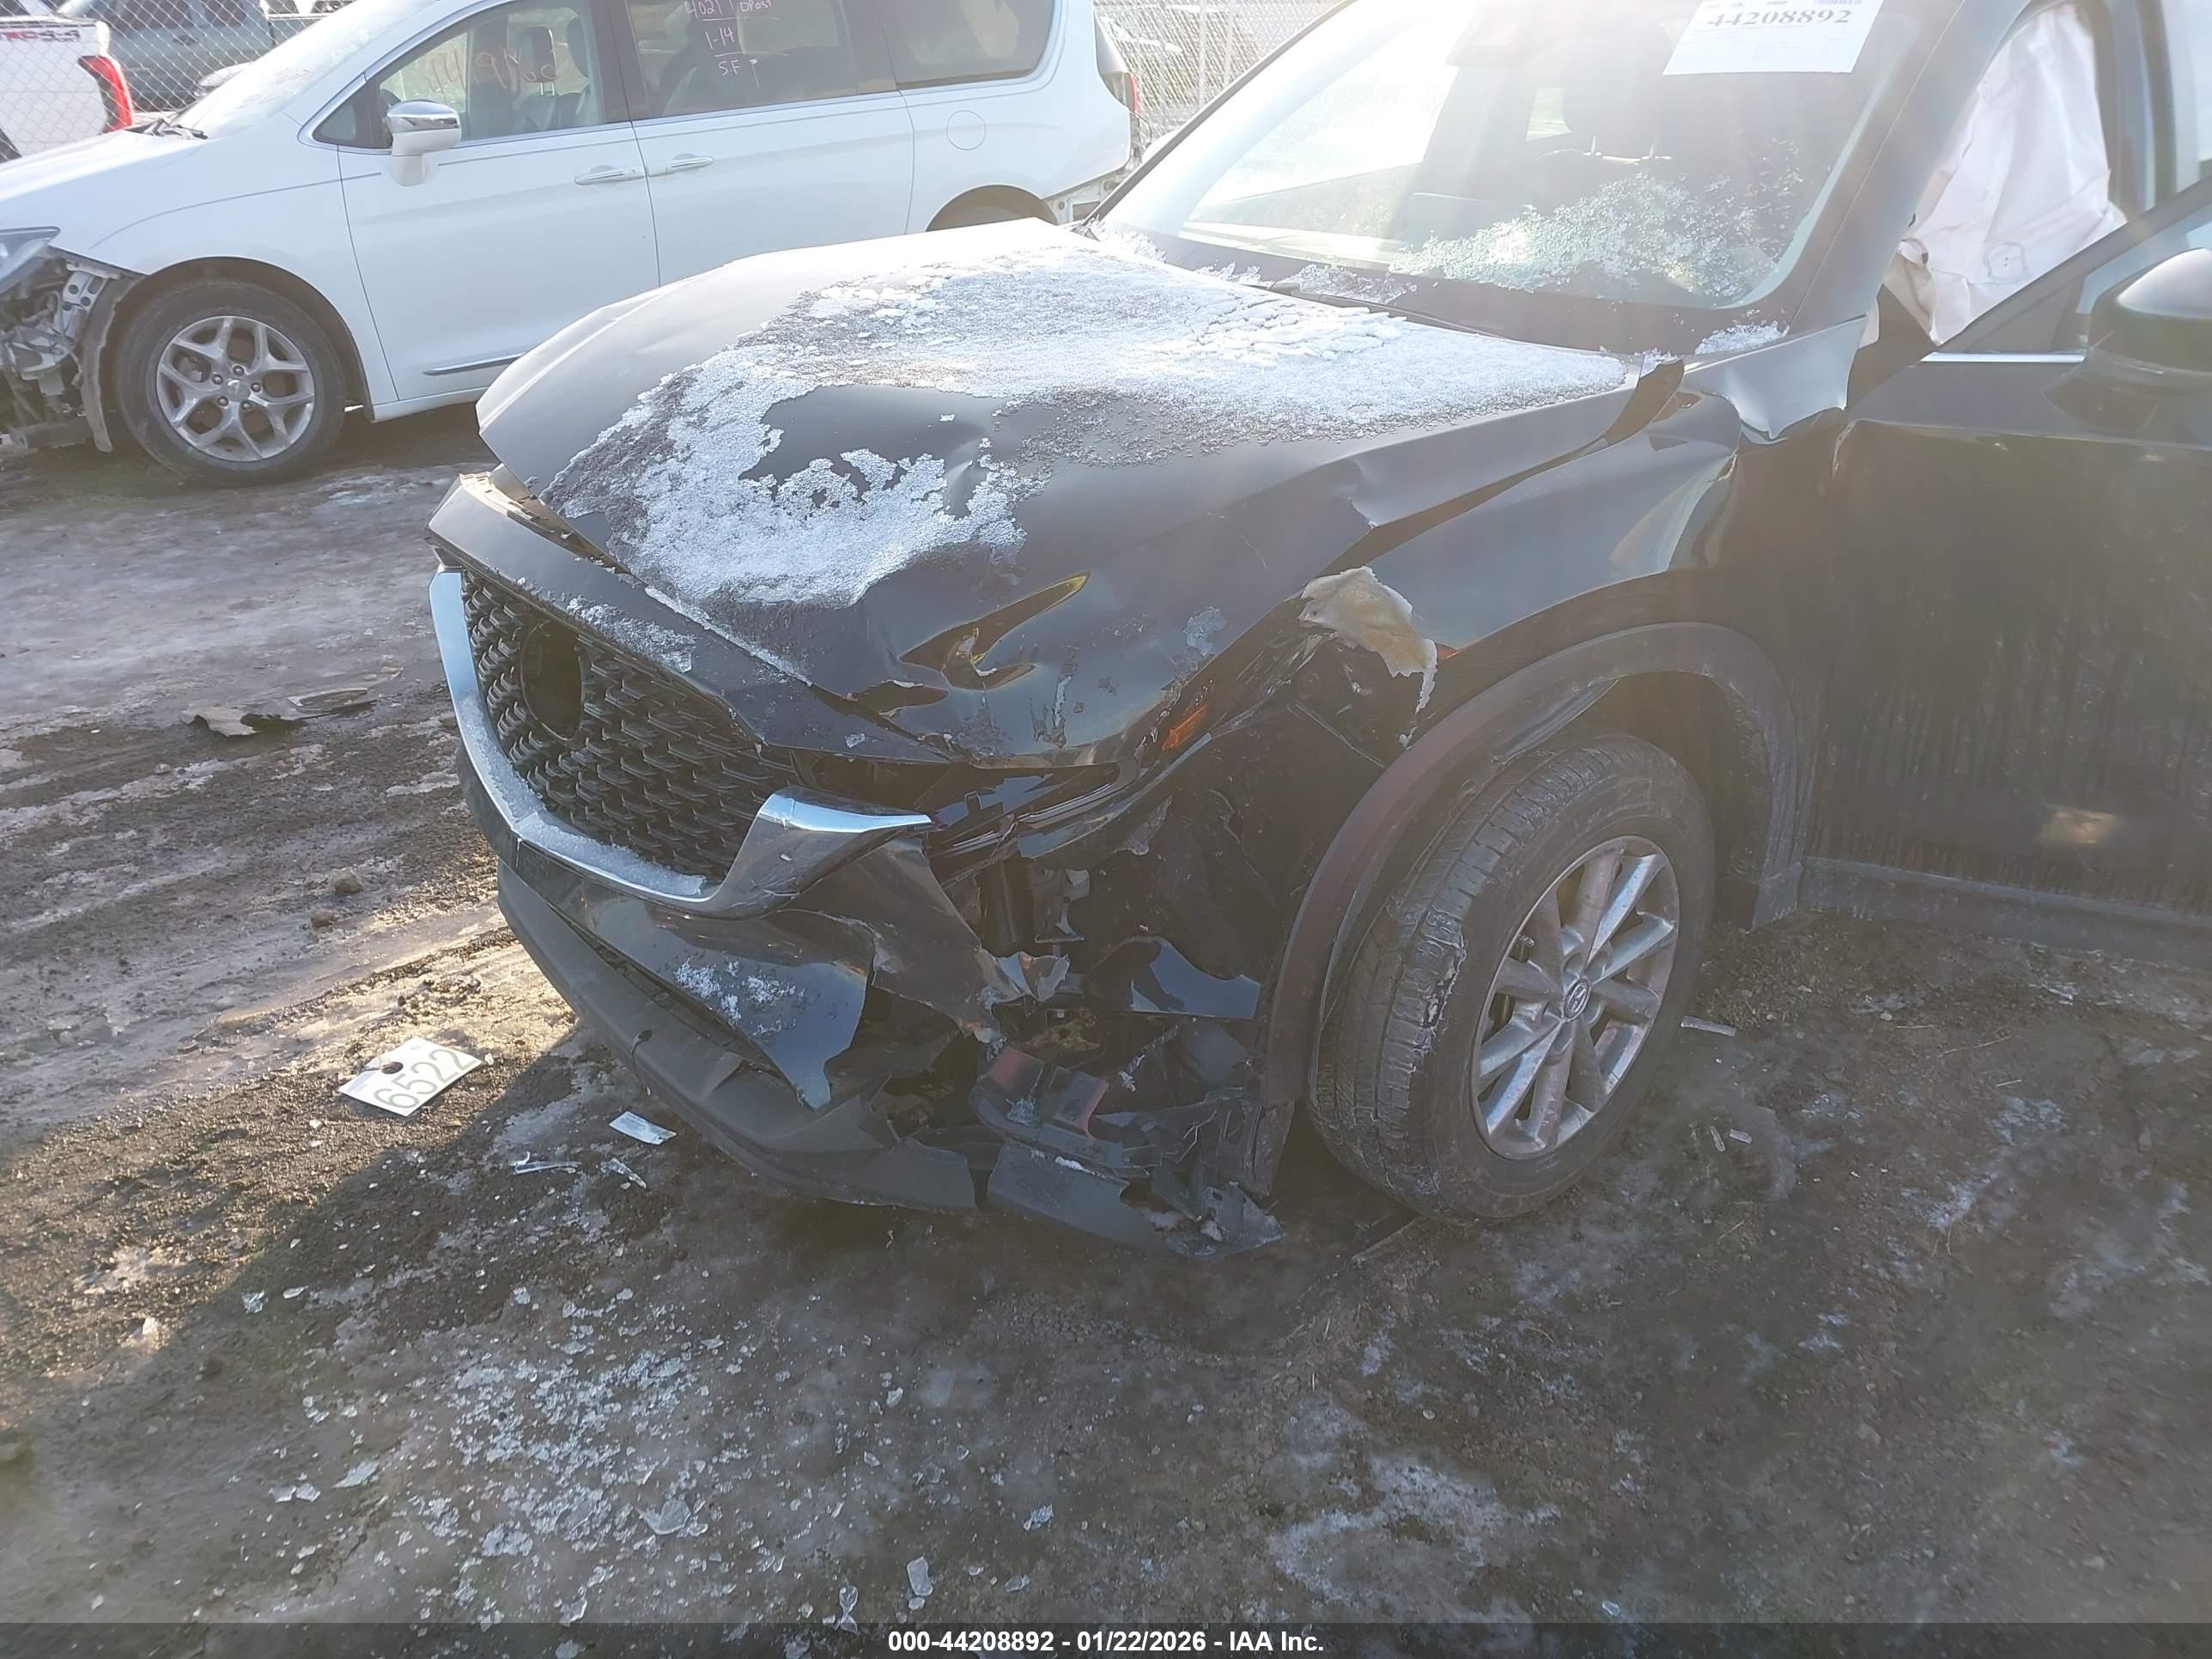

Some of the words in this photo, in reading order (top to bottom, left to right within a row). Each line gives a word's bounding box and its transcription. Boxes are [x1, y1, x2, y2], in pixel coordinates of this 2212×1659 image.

[1708, 9, 1852, 26] 44208892
[704, 27, 735, 50] 1-14
[374, 1048, 477, 1109] 6522
